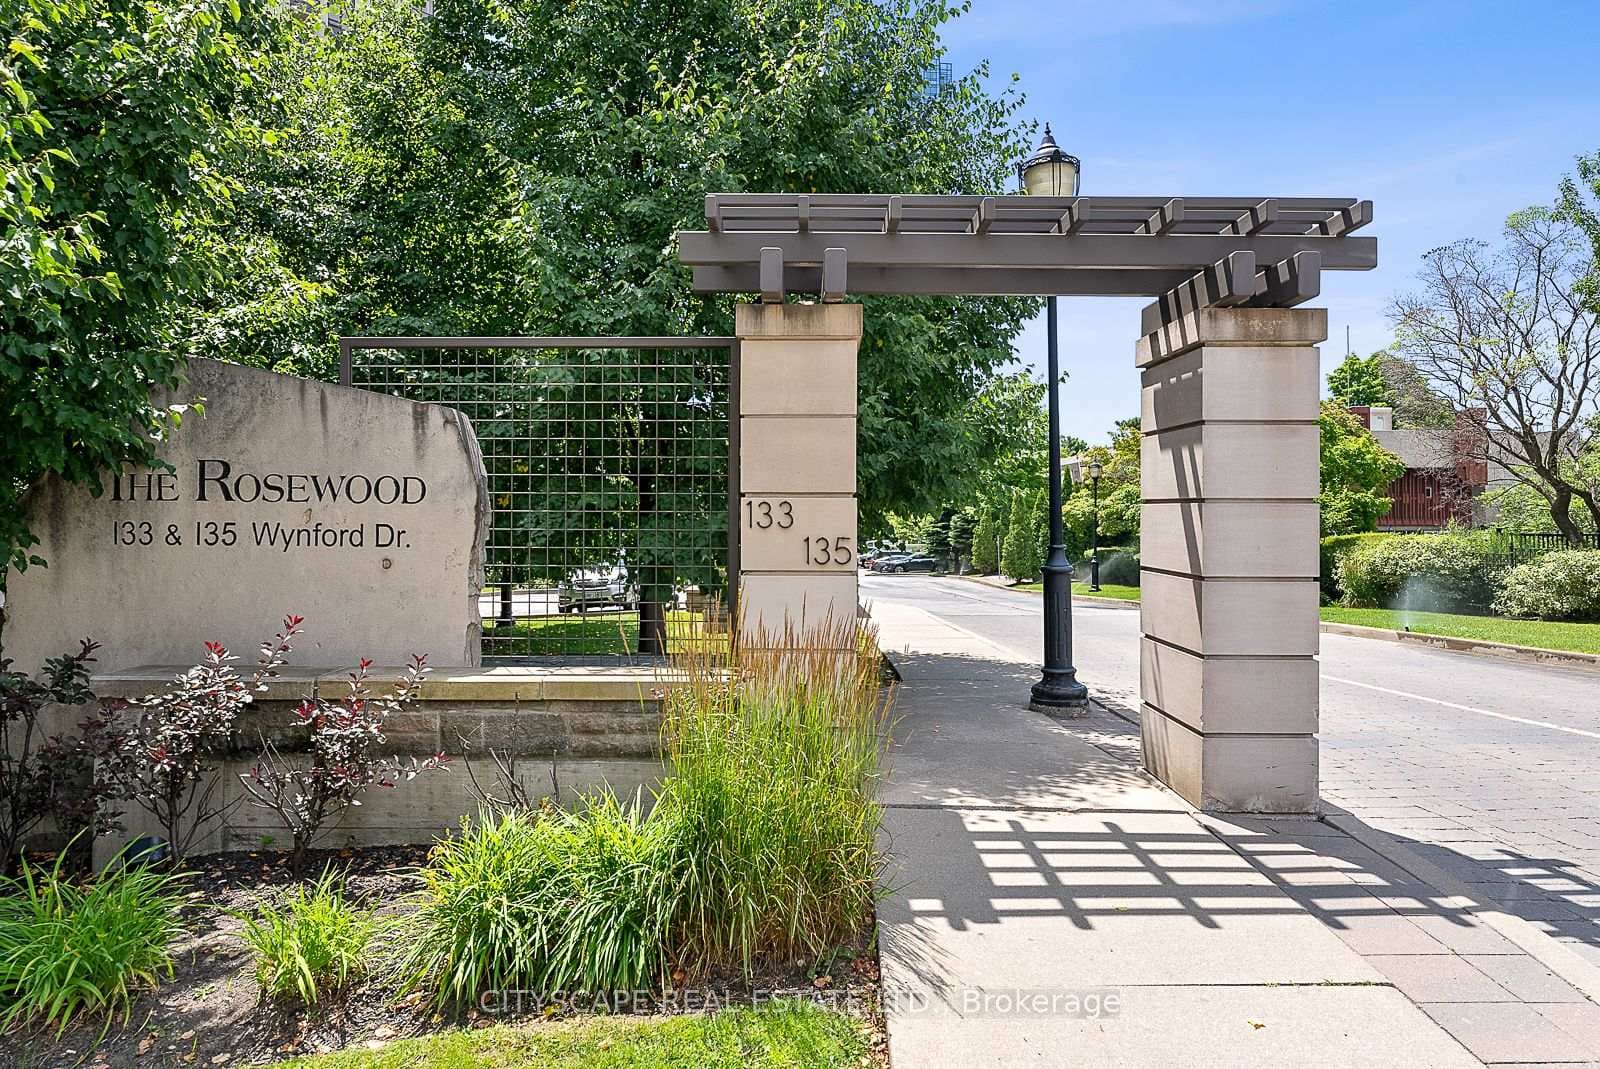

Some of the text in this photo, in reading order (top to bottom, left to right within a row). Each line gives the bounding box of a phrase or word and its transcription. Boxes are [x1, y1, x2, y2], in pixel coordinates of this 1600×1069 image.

[111, 458, 426, 504] THE ROSEWOOD
[746, 501, 794, 529] 133
[113, 521, 411, 552] 133 & 135 Wynford Dr.
[803, 536, 852, 566] 135
